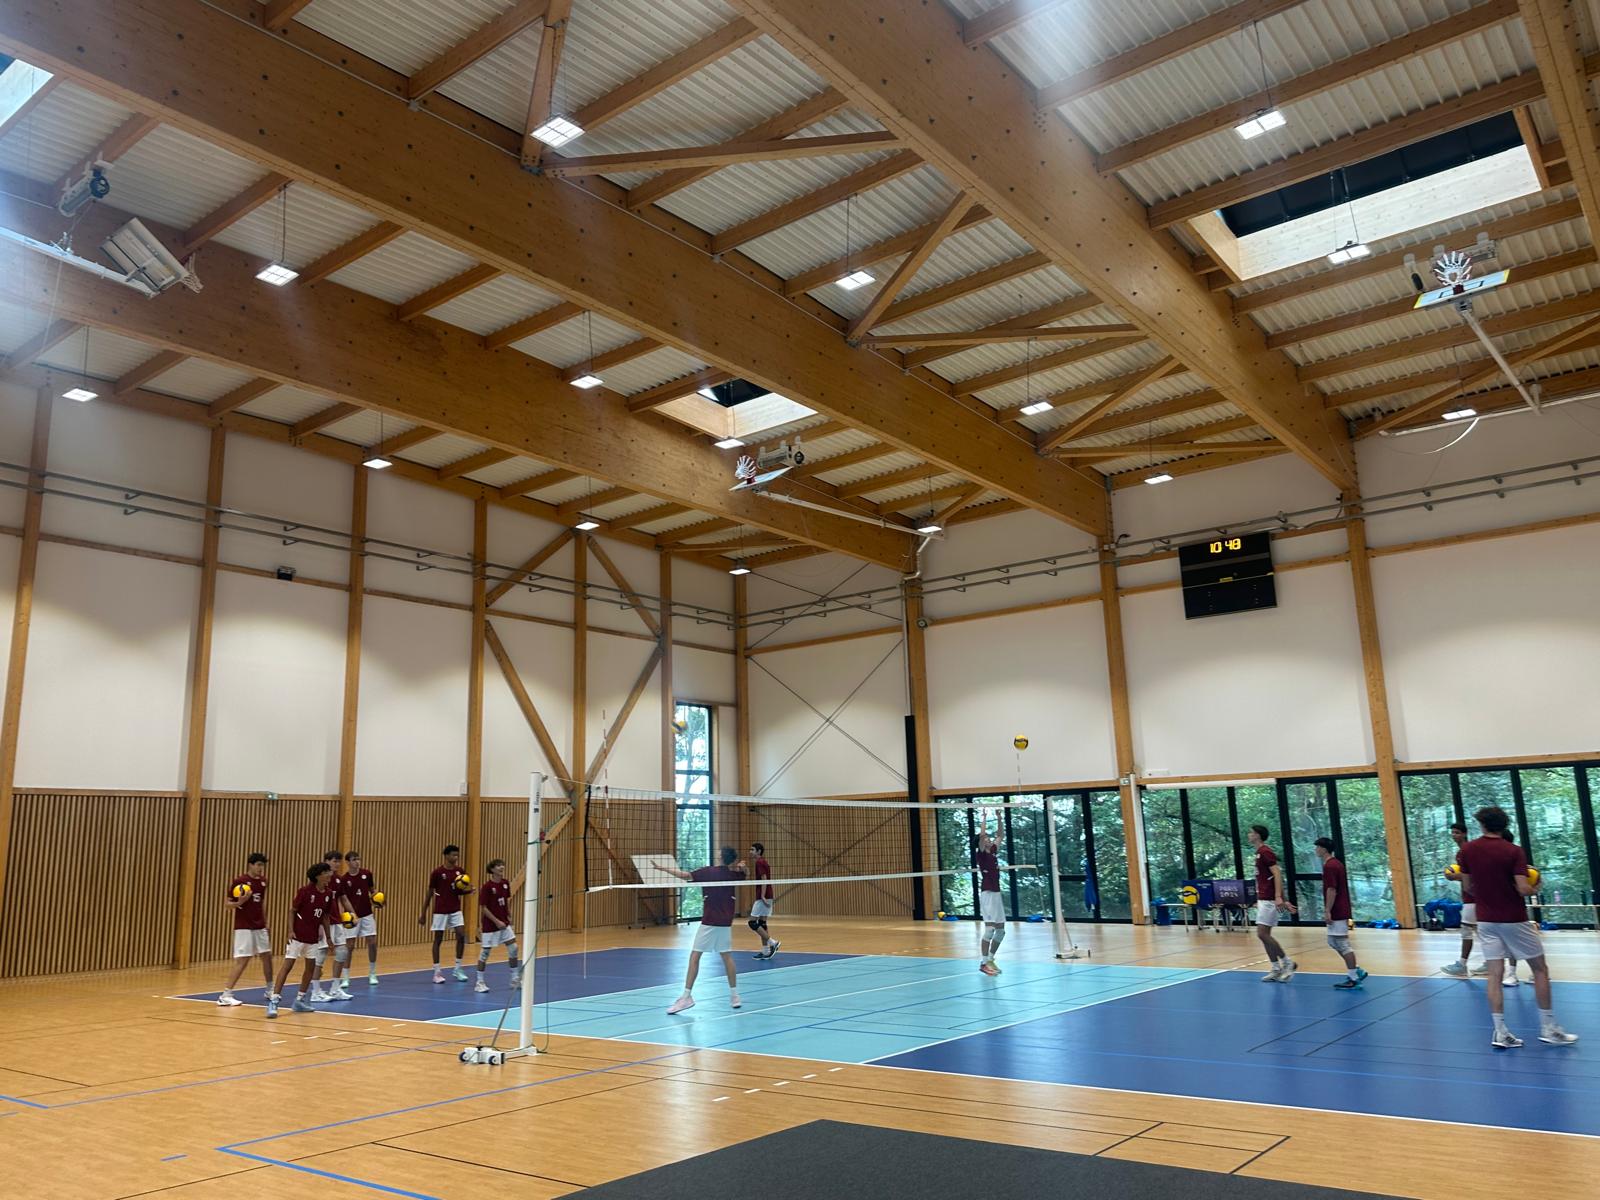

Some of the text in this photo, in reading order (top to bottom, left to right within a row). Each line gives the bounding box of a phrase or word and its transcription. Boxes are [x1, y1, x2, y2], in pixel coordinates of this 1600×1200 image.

[1210, 538, 1241, 553] 10 48
[314, 908, 323, 918] 10
